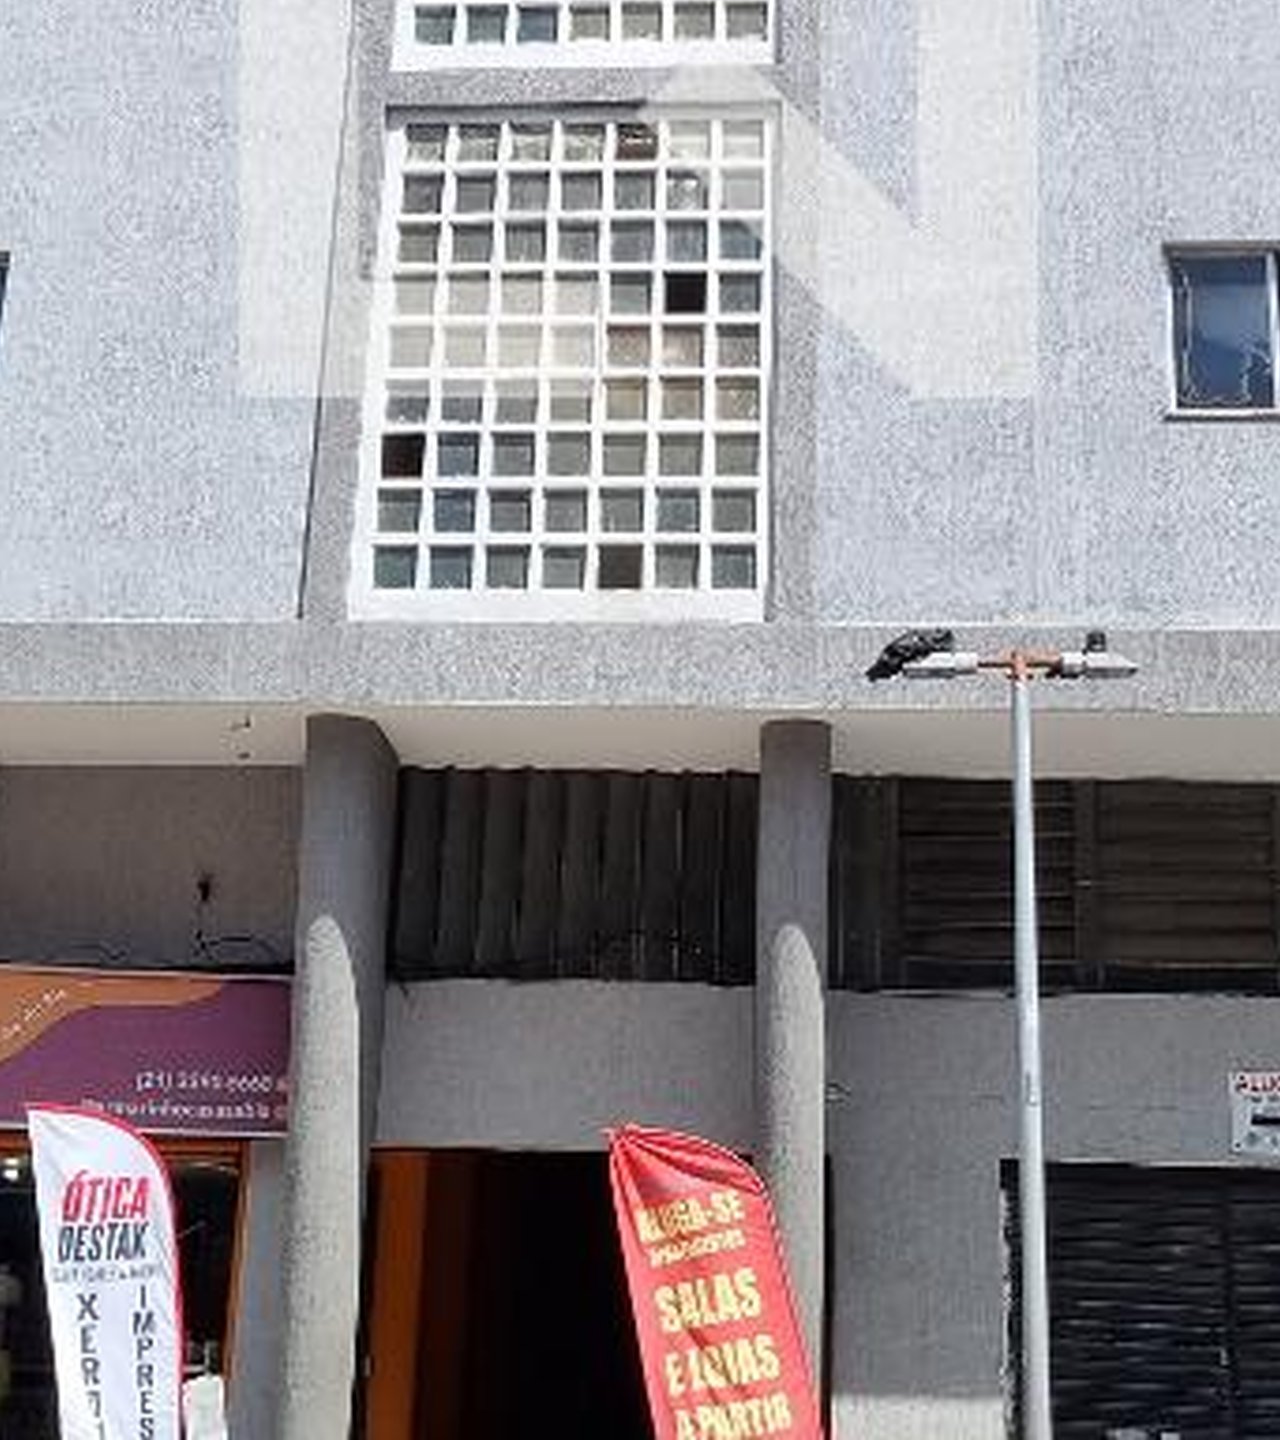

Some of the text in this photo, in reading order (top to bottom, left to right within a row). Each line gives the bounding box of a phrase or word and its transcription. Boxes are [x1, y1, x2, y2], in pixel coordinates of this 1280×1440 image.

[62, 1169, 149, 1223] ÓTICA
[58, 1221, 149, 1263] DESTAK
[653, 1266, 762, 1333] SALAS
[665, 1351, 686, 1399] E
